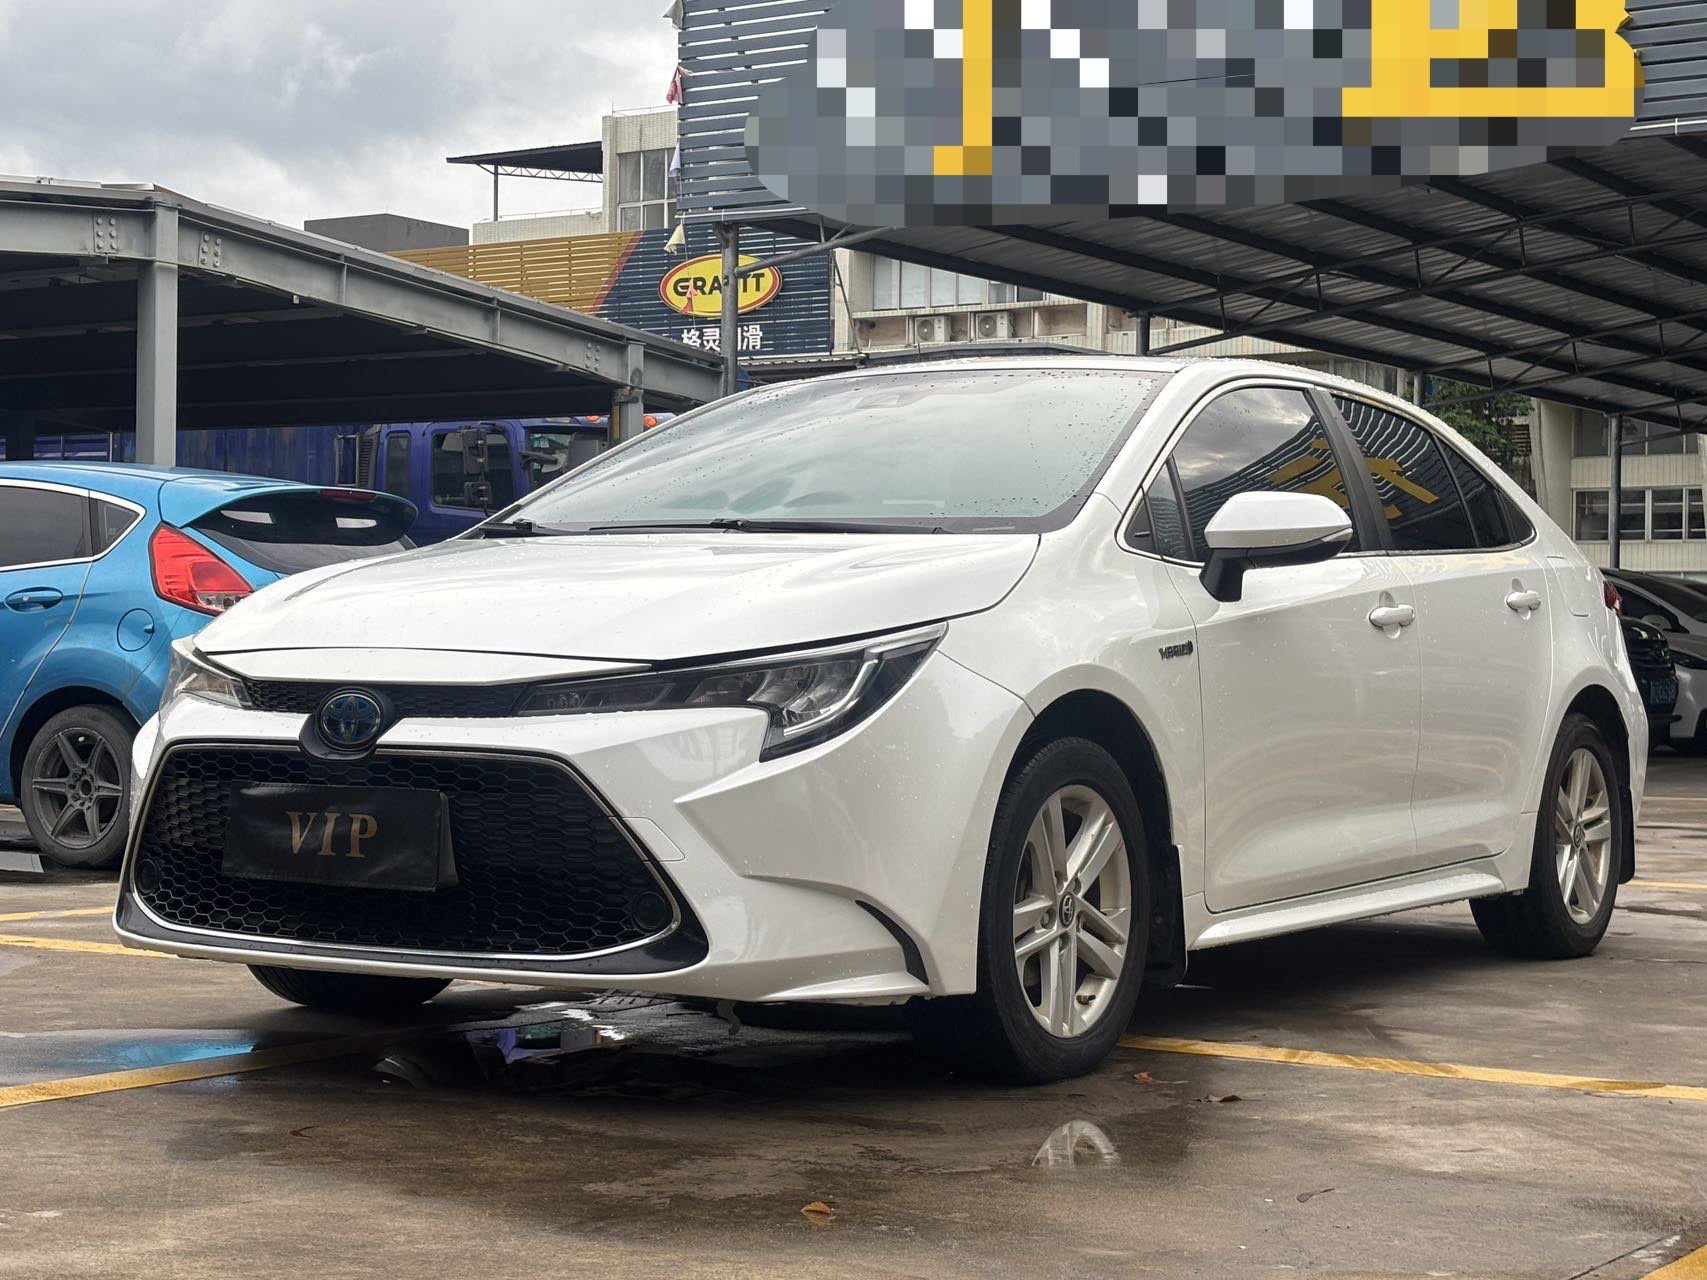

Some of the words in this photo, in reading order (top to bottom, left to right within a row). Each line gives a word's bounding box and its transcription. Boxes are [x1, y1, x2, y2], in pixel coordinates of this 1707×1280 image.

[673, 273, 765, 296] GRATT
[681, 325, 763, 352] 格灵滑
[286, 811, 378, 858] VIP
